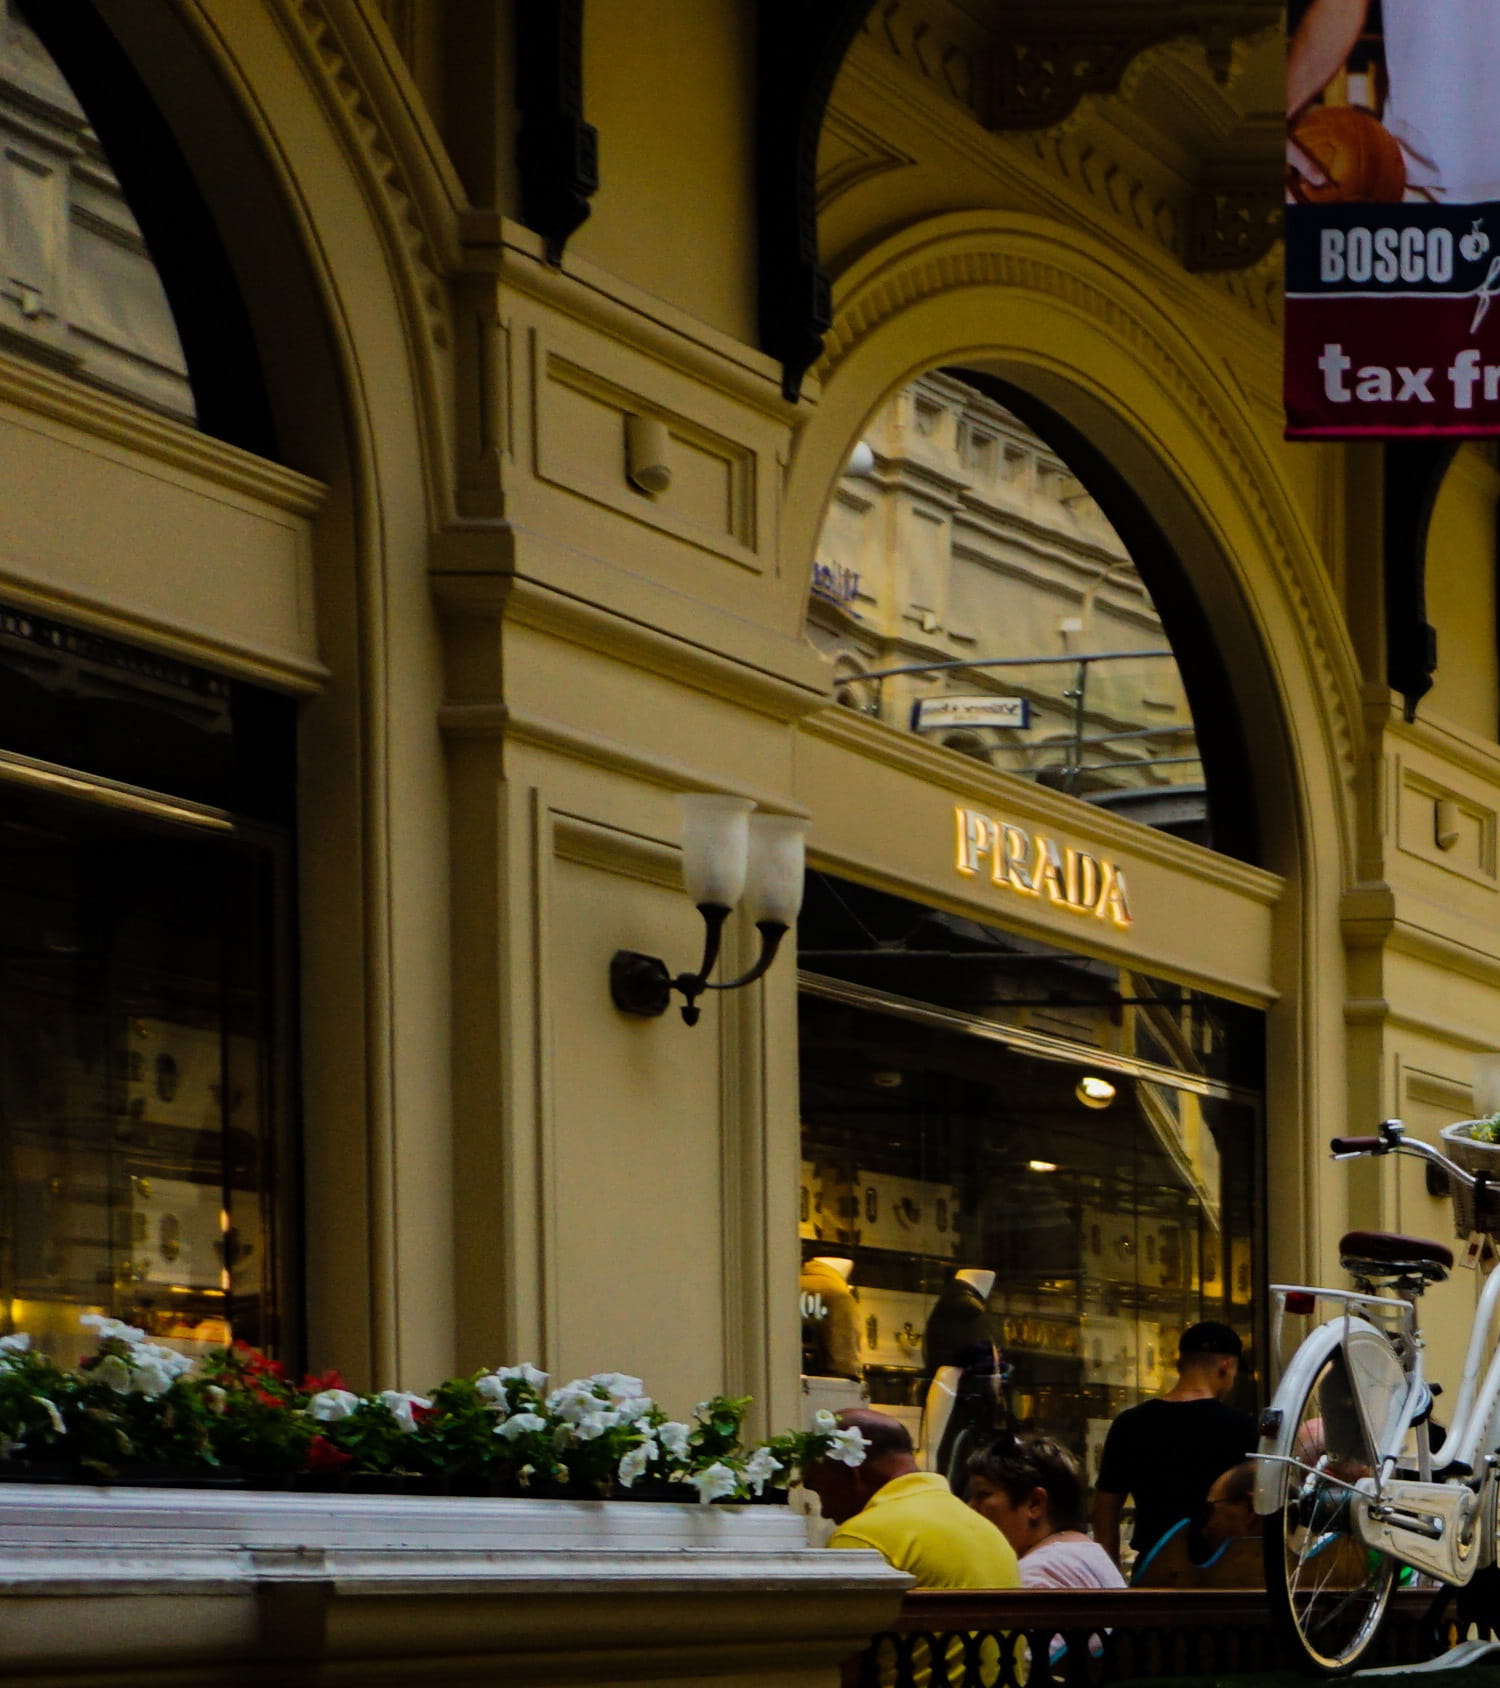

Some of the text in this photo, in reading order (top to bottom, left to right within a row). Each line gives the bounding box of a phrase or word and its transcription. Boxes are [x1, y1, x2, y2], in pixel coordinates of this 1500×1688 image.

[1321, 228, 1453, 284] BOSCO
[1318, 344, 1435, 403] tax
[954, 806, 1134, 928] PRADA
